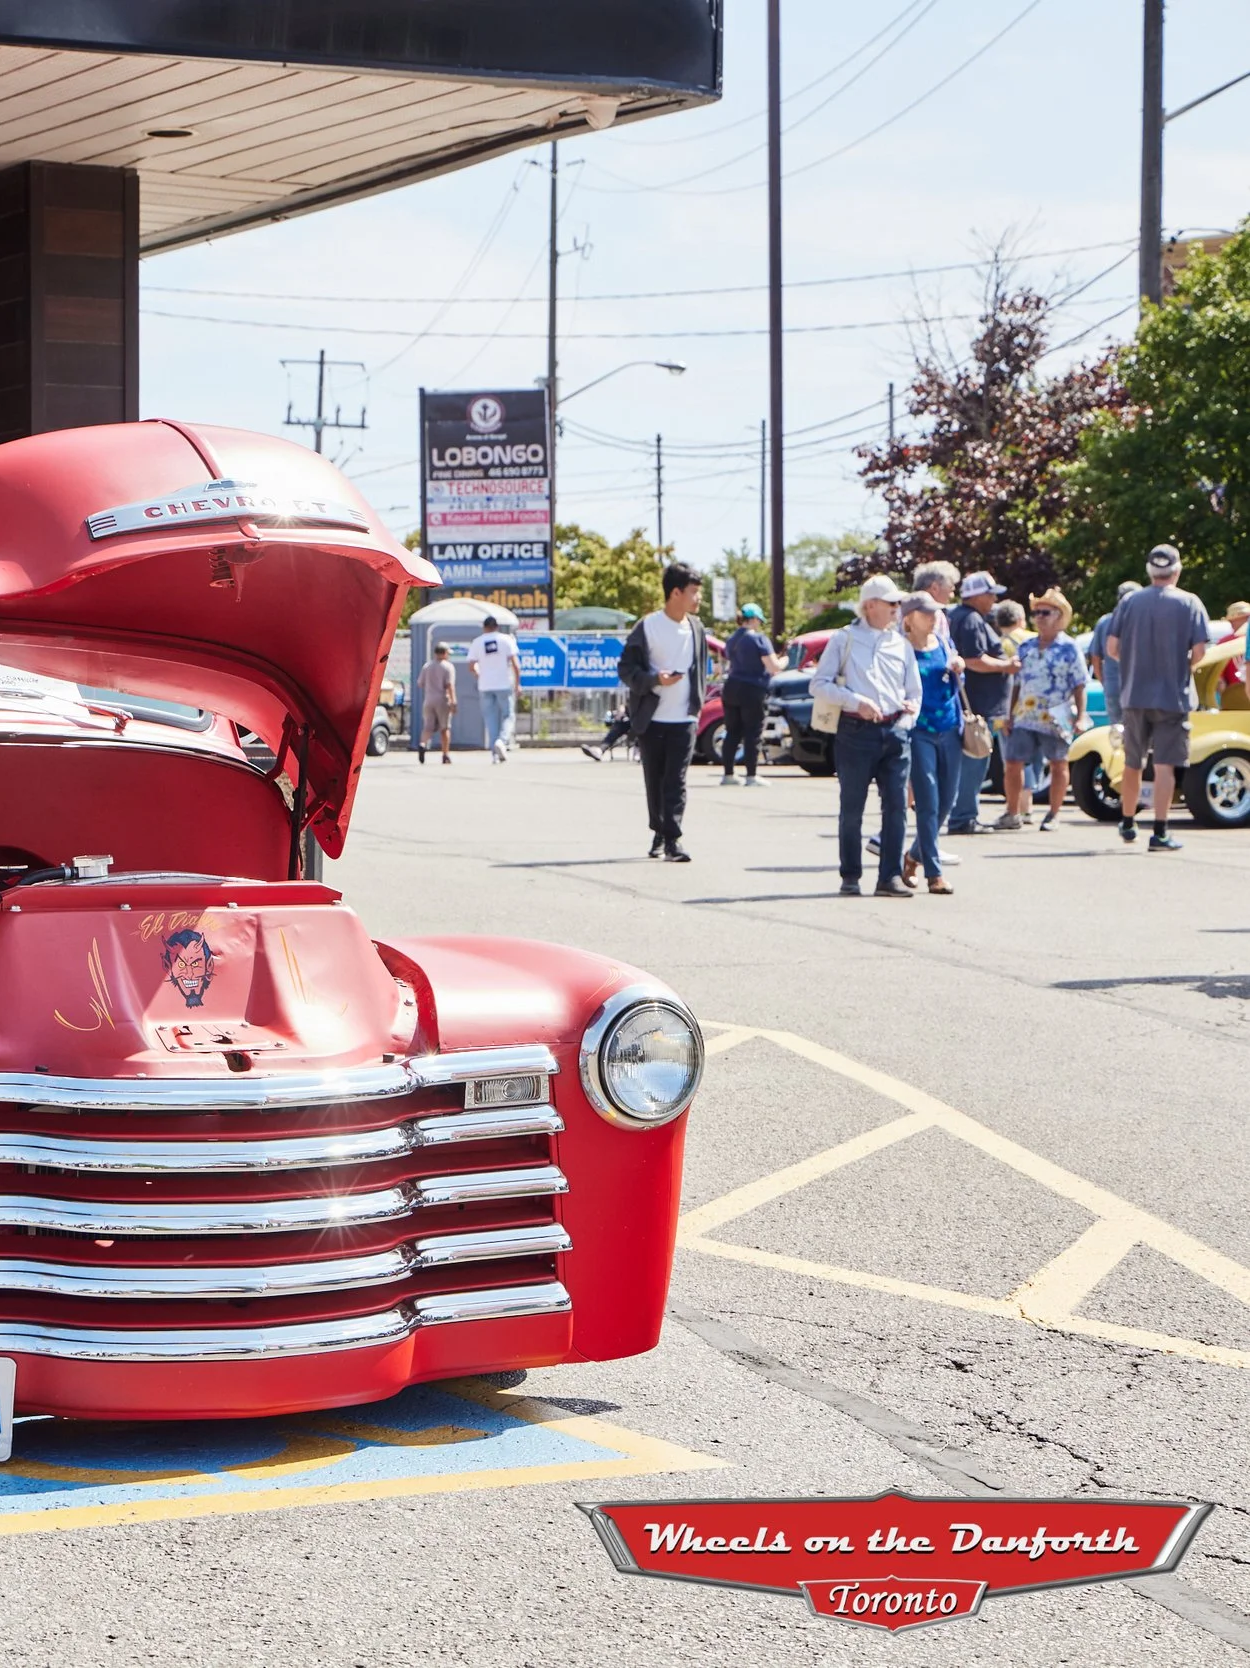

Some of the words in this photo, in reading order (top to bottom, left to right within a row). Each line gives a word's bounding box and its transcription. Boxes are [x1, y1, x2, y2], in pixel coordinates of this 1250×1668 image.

[432, 444, 544, 467] LOBONGO
[447, 480, 545, 495] TECHNOSOURCE
[143, 496, 327, 518] CHEVROET
[432, 545, 473, 561] LAW
[477, 543, 545, 560] OFFICE
[442, 564, 483, 580] AMIN
[569, 656, 622, 671] TARUN
